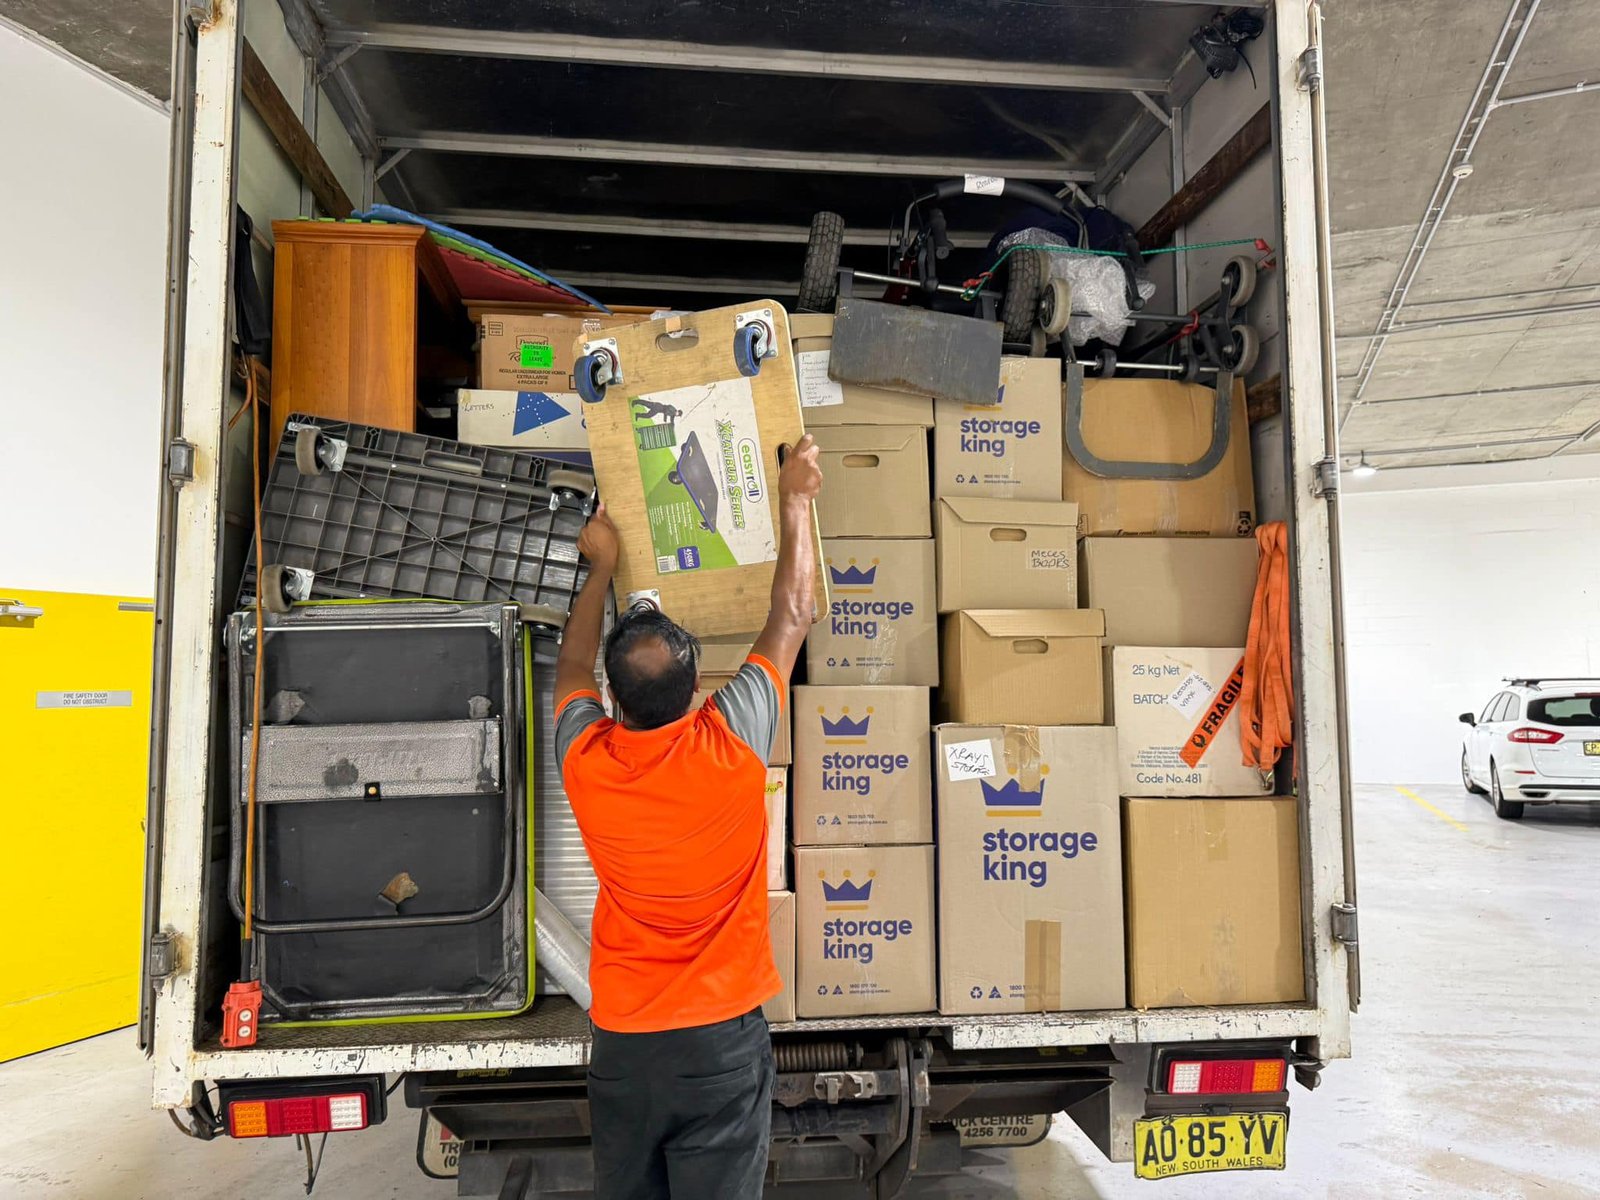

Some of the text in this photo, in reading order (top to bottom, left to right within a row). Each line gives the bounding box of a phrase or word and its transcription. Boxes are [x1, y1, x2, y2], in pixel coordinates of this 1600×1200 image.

[960, 417, 1041, 438] storage
[960, 434, 1005, 458] king
[831, 598, 914, 620] storage
[831, 617, 877, 639] king
[1132, 664, 1180, 678] 25 kg Net
[822, 752, 908, 775] storage
[822, 772, 870, 795] king
[1136, 772, 1202, 784] Code No. 481
[982, 828, 1098, 859] storage
[983, 854, 1047, 888] king
[823, 918, 912, 941] storage
[823, 939, 873, 964] king
[964, 1126, 1027, 1137] 4256 7700
[981, 1115, 1033, 1126] CENTRE
[1155, 1157, 1263, 1176] NEW SOUTH WALES
